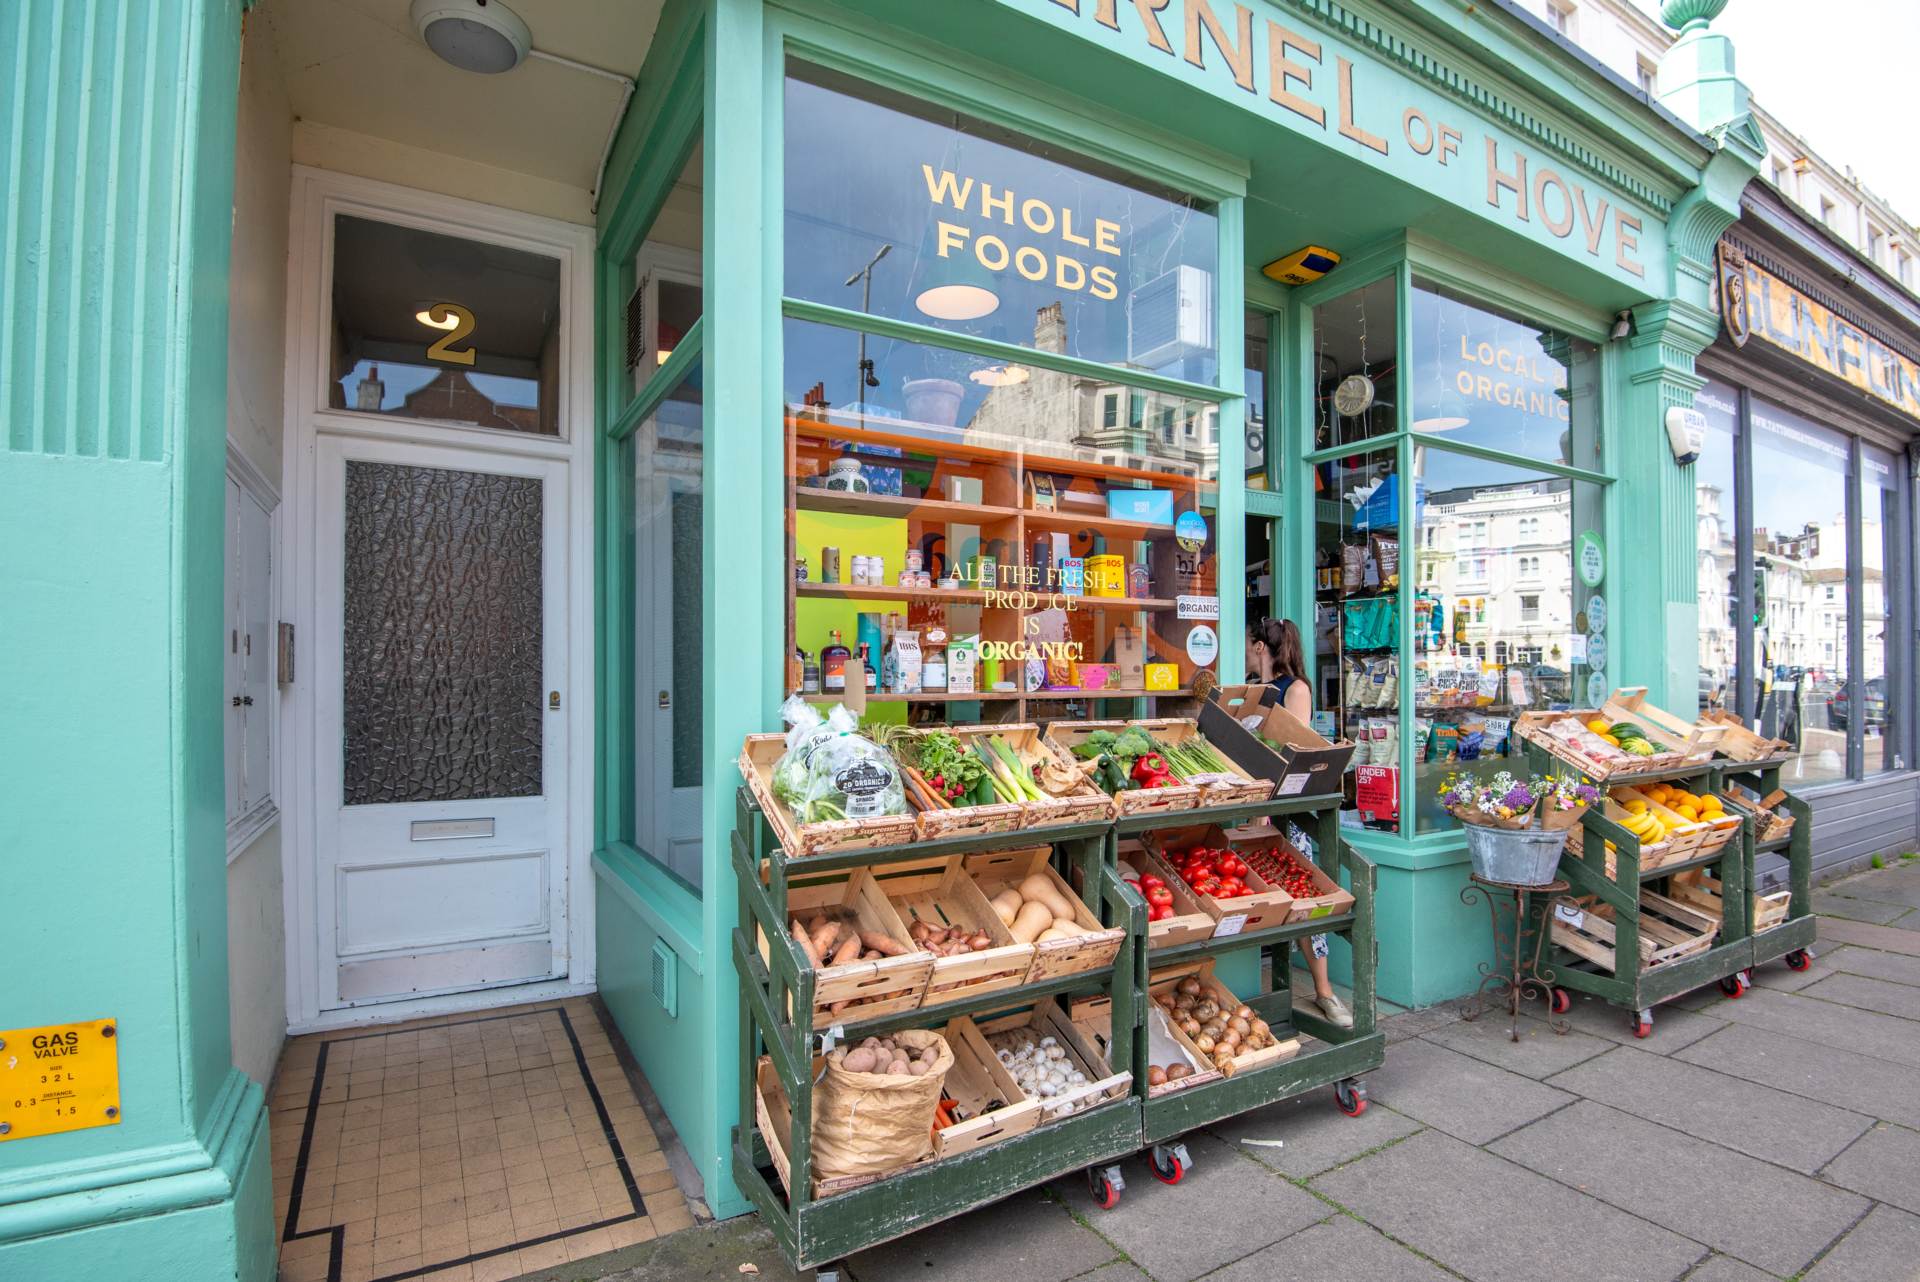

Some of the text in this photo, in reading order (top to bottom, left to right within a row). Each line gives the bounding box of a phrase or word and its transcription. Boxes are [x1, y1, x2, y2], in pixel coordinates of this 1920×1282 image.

[1049, 0, 1645, 279] RNEL OF HOVE
[921, 163, 1121, 257] WHOLE
[936, 221, 1119, 301] FOODS
[426, 302, 477, 367] 2
[1461, 335, 1545, 383] LOCAL
[1457, 371, 1570, 422] ORGANIC
[950, 562, 992, 583] ALL
[998, 564, 1040, 586] THE
[1045, 567, 1107, 589] FRESH
[1179, 602, 1219, 614] ORGANIC
[1024, 616, 1040, 636] IS
[978, 640, 1084, 661] ORGANIC!
[1485, 719, 1507, 731] SHORE
[1553, 744, 1587, 770] Supreme
[1358, 767, 1386, 777] UNDER
[1358, 775, 1372, 785] 25?
[859, 825, 897, 835] Supreme
[32, 1031, 79, 1049] GAS
[34, 1045, 79, 1059] VALVE
